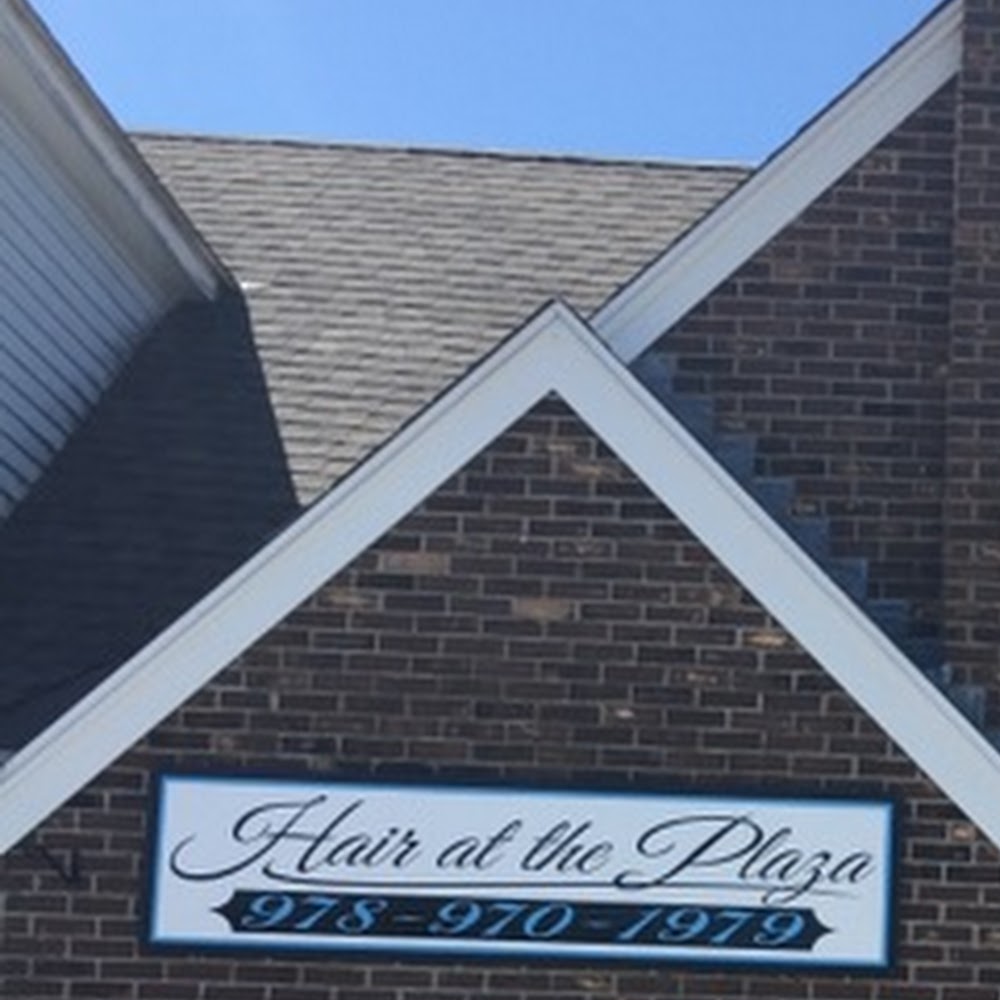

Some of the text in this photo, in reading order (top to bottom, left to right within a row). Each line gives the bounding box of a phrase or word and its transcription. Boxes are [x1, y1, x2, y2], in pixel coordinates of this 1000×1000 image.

[170, 795, 876, 904] Hair at the Plaza
